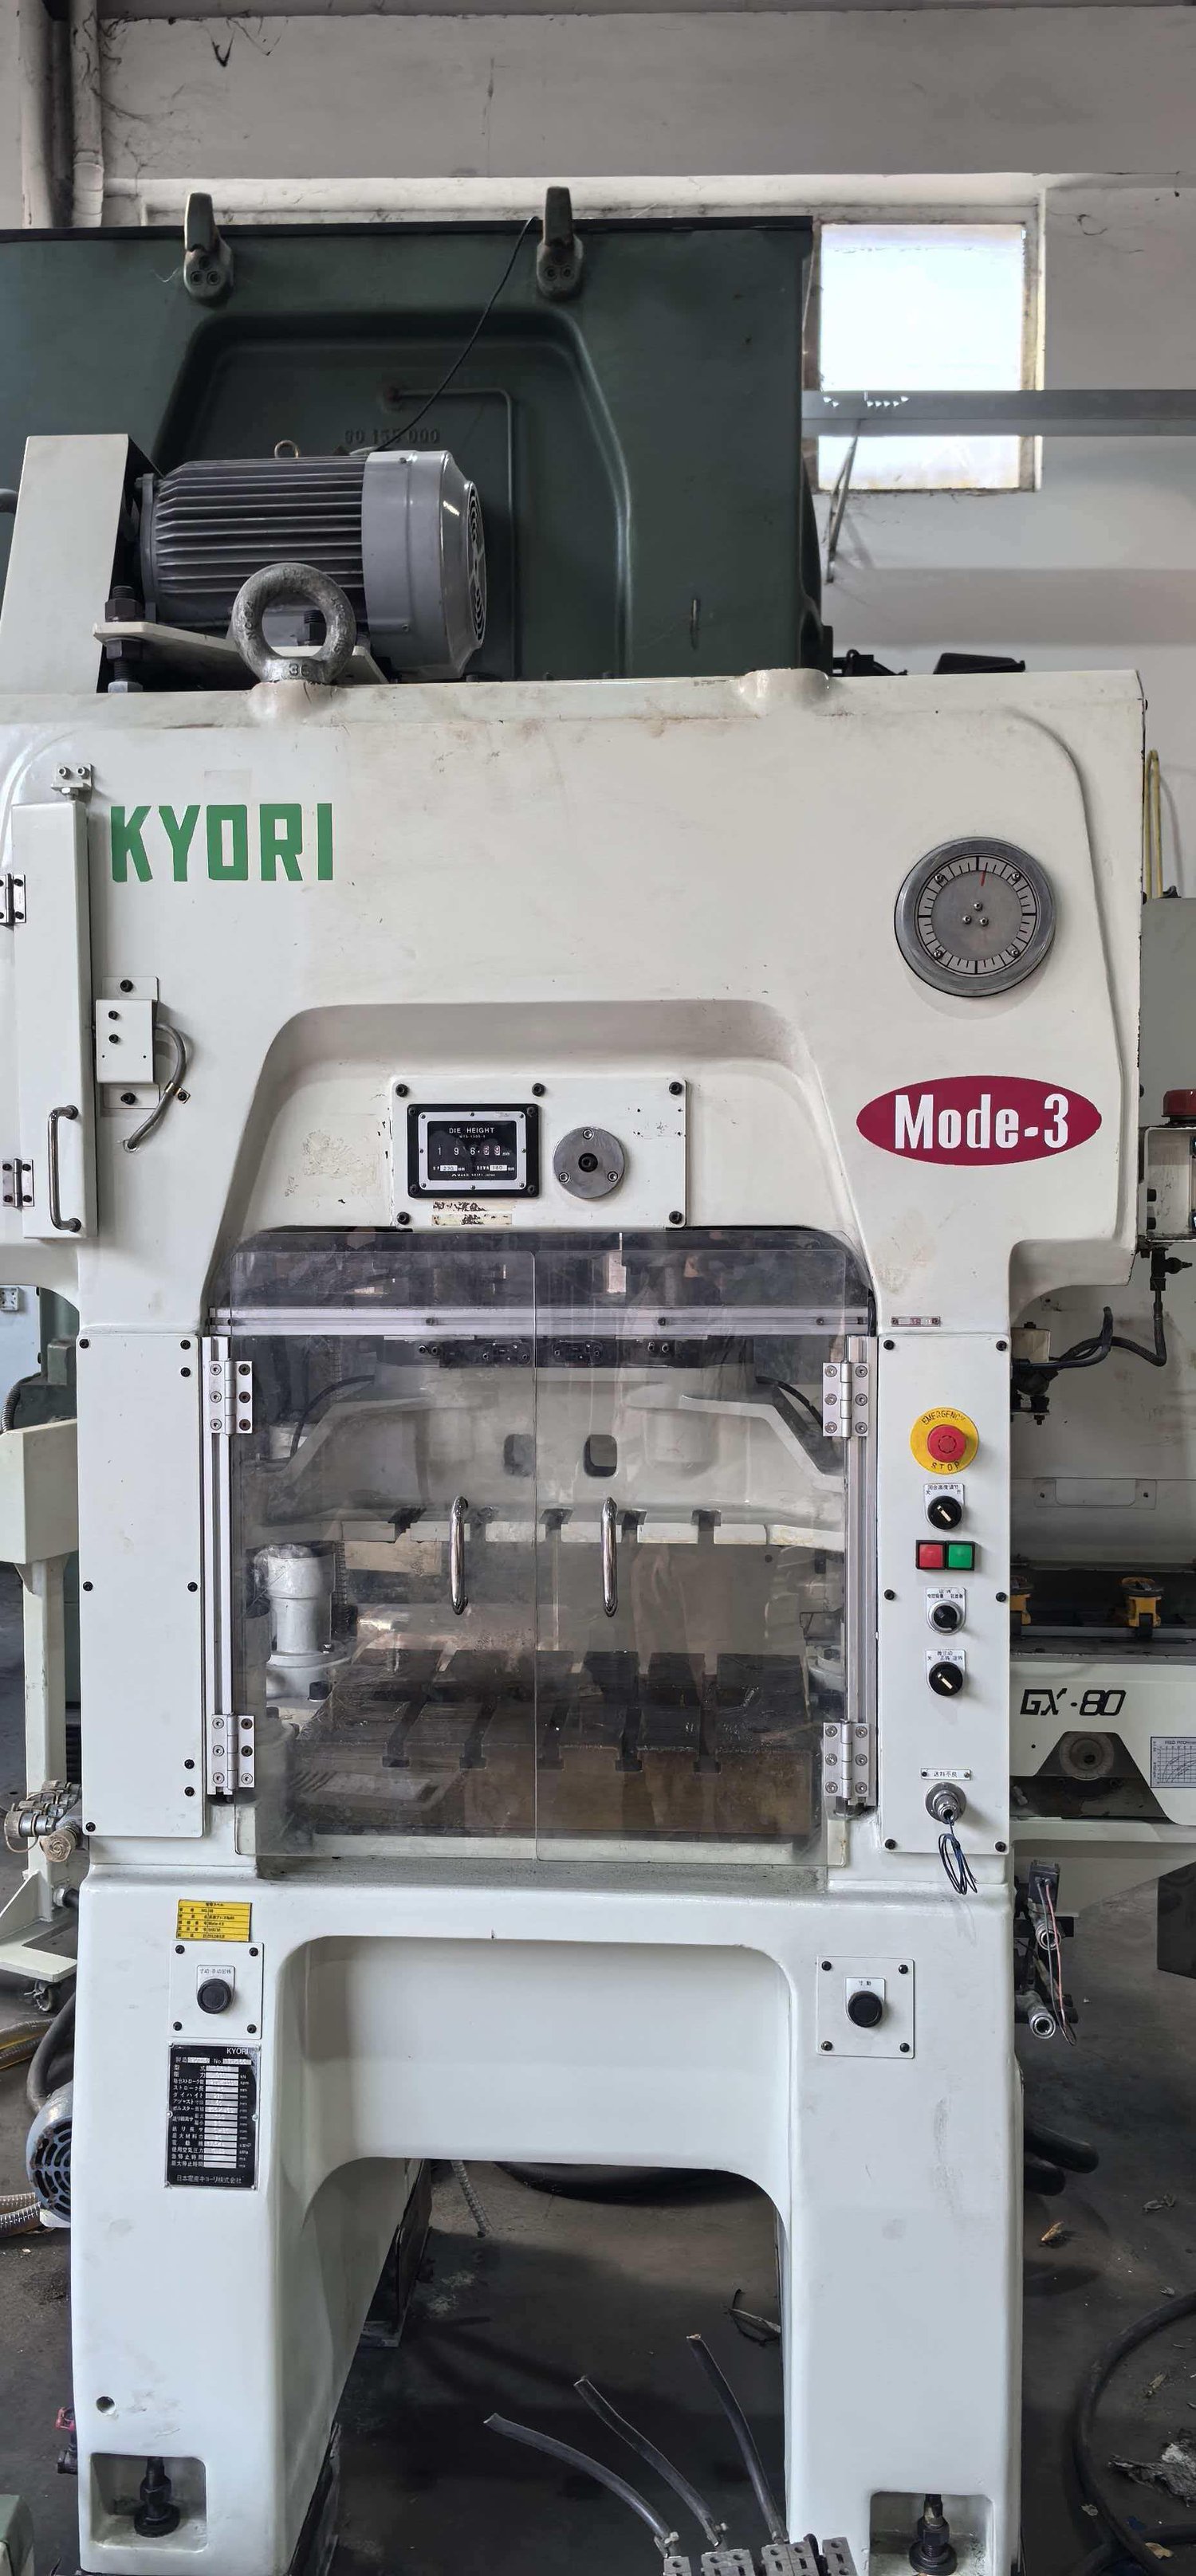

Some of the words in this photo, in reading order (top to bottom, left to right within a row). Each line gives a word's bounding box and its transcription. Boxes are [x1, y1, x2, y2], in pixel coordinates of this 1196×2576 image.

[408, 428, 440, 444] 000
[111, 803, 332, 882] KYORI
[895, 1094, 1068, 1150] Mode-3
[922, 1410, 966, 1425] EMERGENCY
[931, 1460, 960, 1471] STOP
[1021, 1688, 1127, 1716] GX-80
